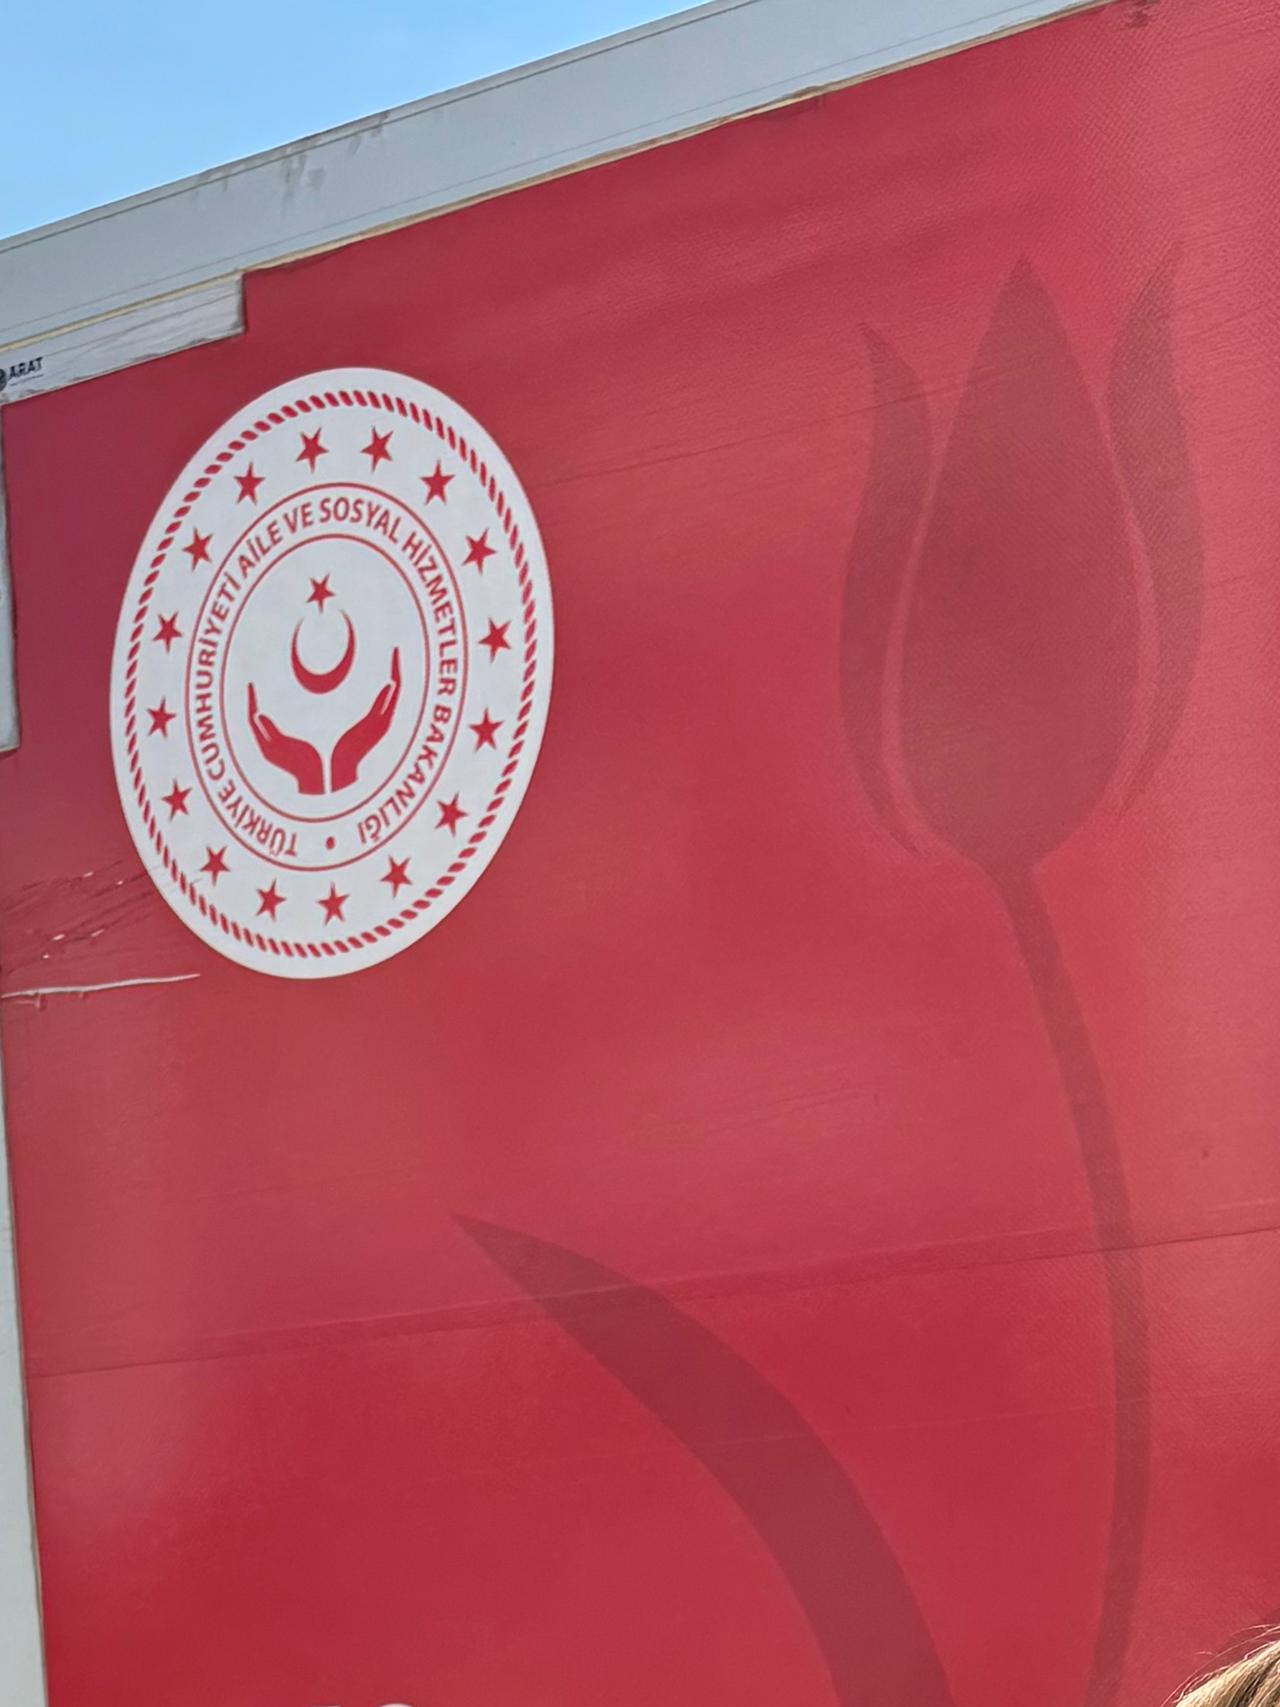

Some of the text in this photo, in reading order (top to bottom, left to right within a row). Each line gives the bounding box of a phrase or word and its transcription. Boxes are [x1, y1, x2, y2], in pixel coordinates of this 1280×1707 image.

[8, 356, 44, 380] ARAT
[194, 497, 458, 858] TÜRKİYE CUMHURİYETİ AİLE VE SOSYAL HİZMETLER BAKANLIĞI
